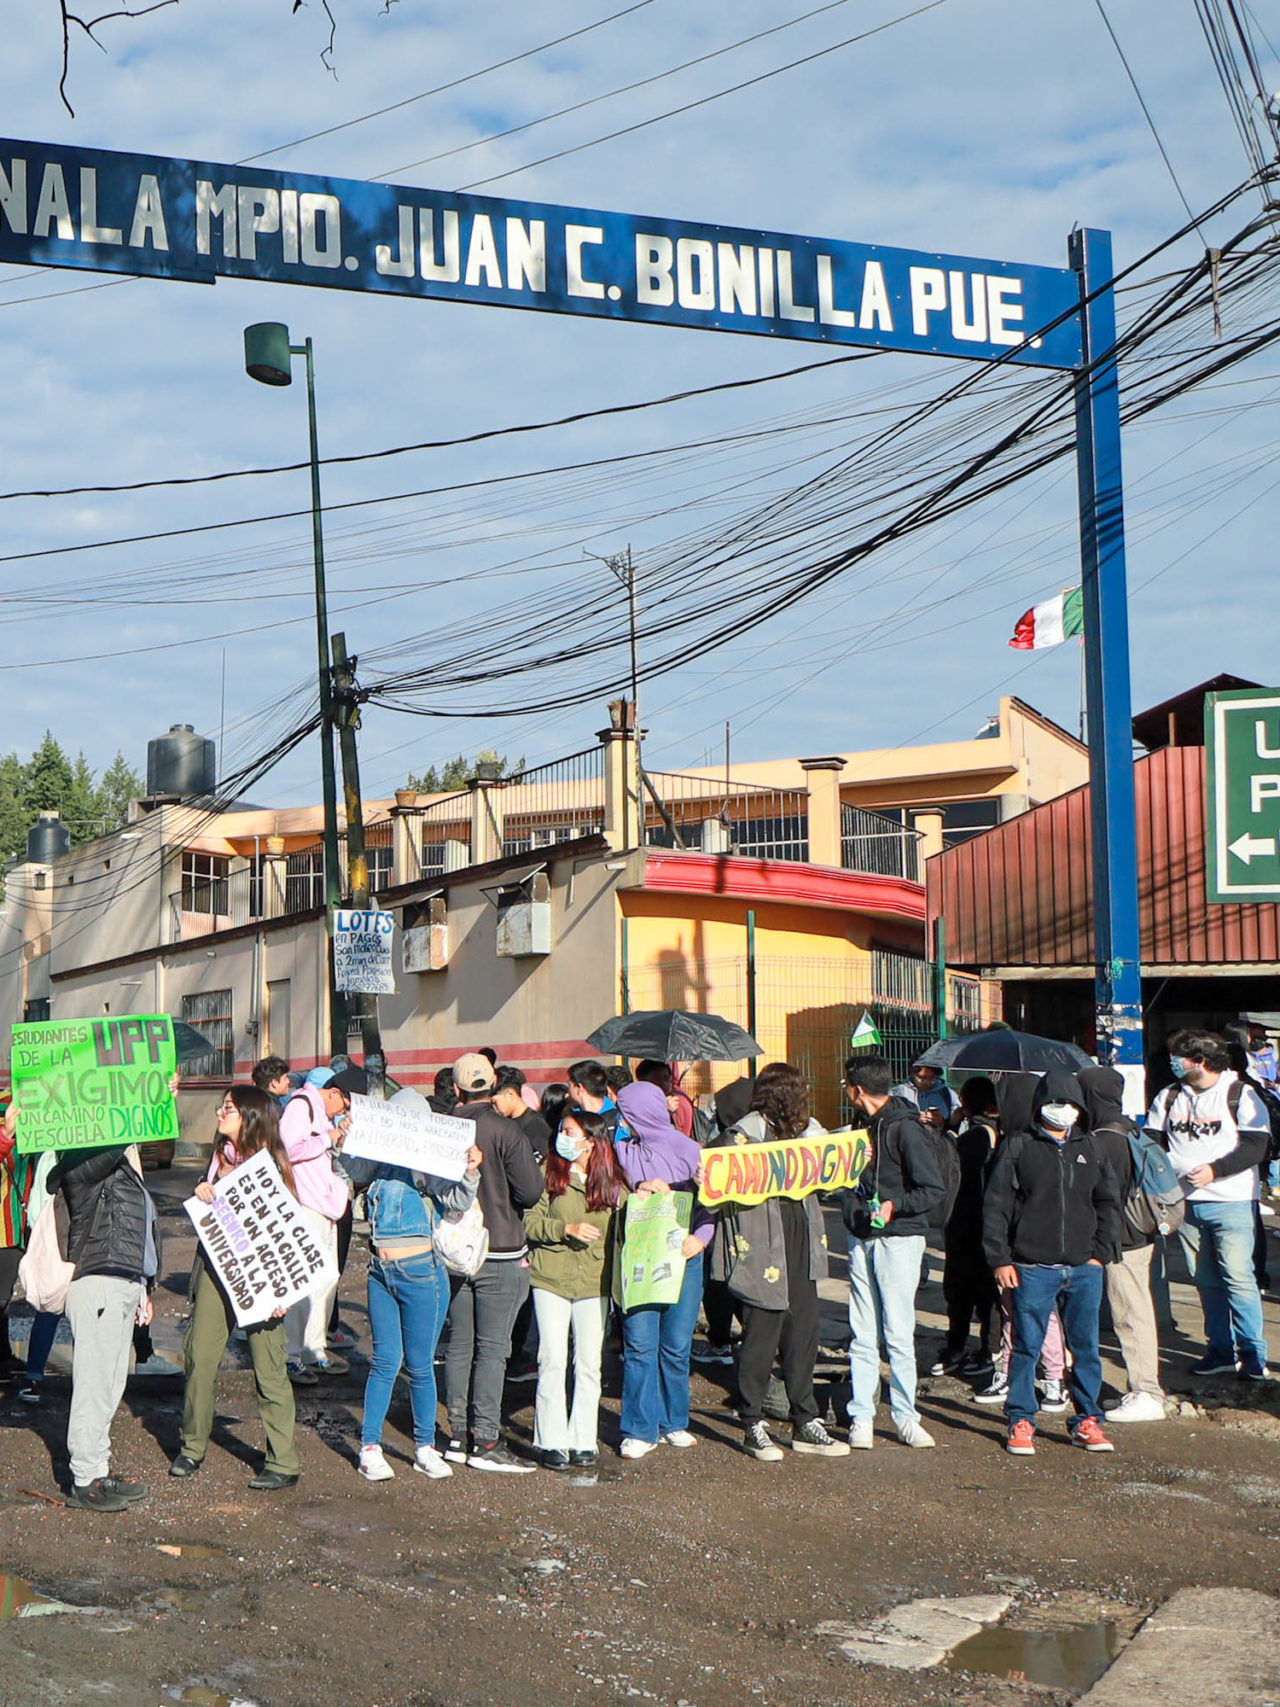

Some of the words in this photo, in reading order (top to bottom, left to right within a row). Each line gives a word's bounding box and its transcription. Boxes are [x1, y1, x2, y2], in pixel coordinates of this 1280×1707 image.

[195, 180, 359, 271] MPIO.
[375, 204, 546, 293] JUAN
[564, 224, 623, 301] C.
[635, 233, 893, 332] BONILLA
[909, 266, 1041, 349] PUE.
[1250, 774, 1280, 813] P
[337, 911, 394, 934] LOTES
[11, 1026, 89, 1047] ESTUDIANTES
[91, 1019, 171, 1068] UPP
[19, 1050, 39, 1067] DE
[50, 1047, 74, 1067] LA
[17, 1069, 174, 1111] EXIGIMOS
[396, 1105, 408, 1117] ES
[108, 1103, 173, 1139] DIGNOS
[238, 1174, 255, 1195] ES
[250, 1195, 270, 1220] EN
[210, 1195, 250, 1253] SEGURO
[225, 1186, 245, 1216] POR
[243, 1216, 263, 1243] UN
[256, 1242, 288, 1299] ACCESO
[255, 1166, 279, 1199] HOY
[277, 1201, 294, 1222] LA
[291, 1225, 324, 1275] CLASE
[198, 1210, 255, 1311] UNIVERSIDAD
